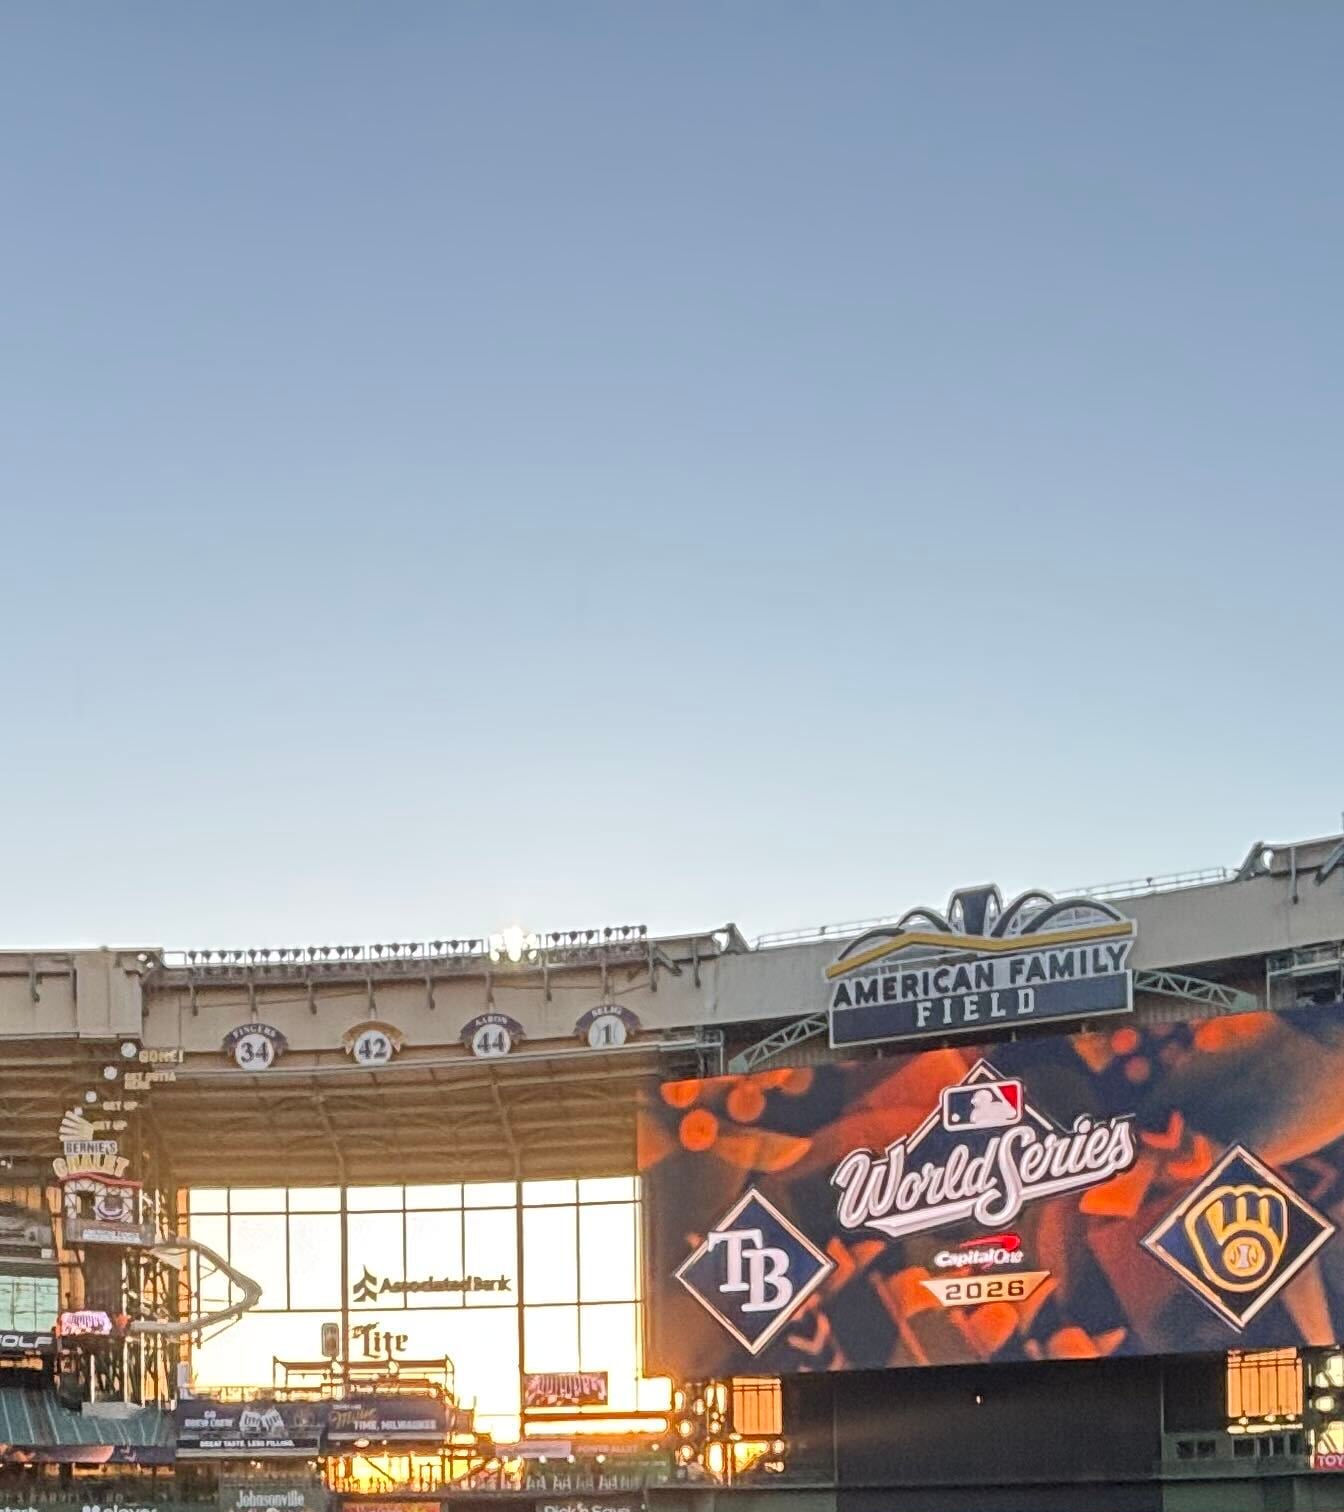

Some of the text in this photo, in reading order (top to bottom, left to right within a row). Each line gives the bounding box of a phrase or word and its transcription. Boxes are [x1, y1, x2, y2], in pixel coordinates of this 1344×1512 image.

[833, 942, 1128, 1008] AMERICAN FAMILY
[916, 987, 1036, 1028] FIELD
[477, 1031, 506, 1054] 44
[600, 1024, 614, 1045] 1
[240, 1040, 270, 1063] 34
[359, 1038, 386, 1058] 42
[835, 1118, 1135, 1228] World Series
[707, 1228, 794, 1312] TB
[379, 1274, 512, 1294] Associated Bank
[945, 1280, 1025, 1301] 2026
[236, 1490, 305, 1508] Johnsonville
